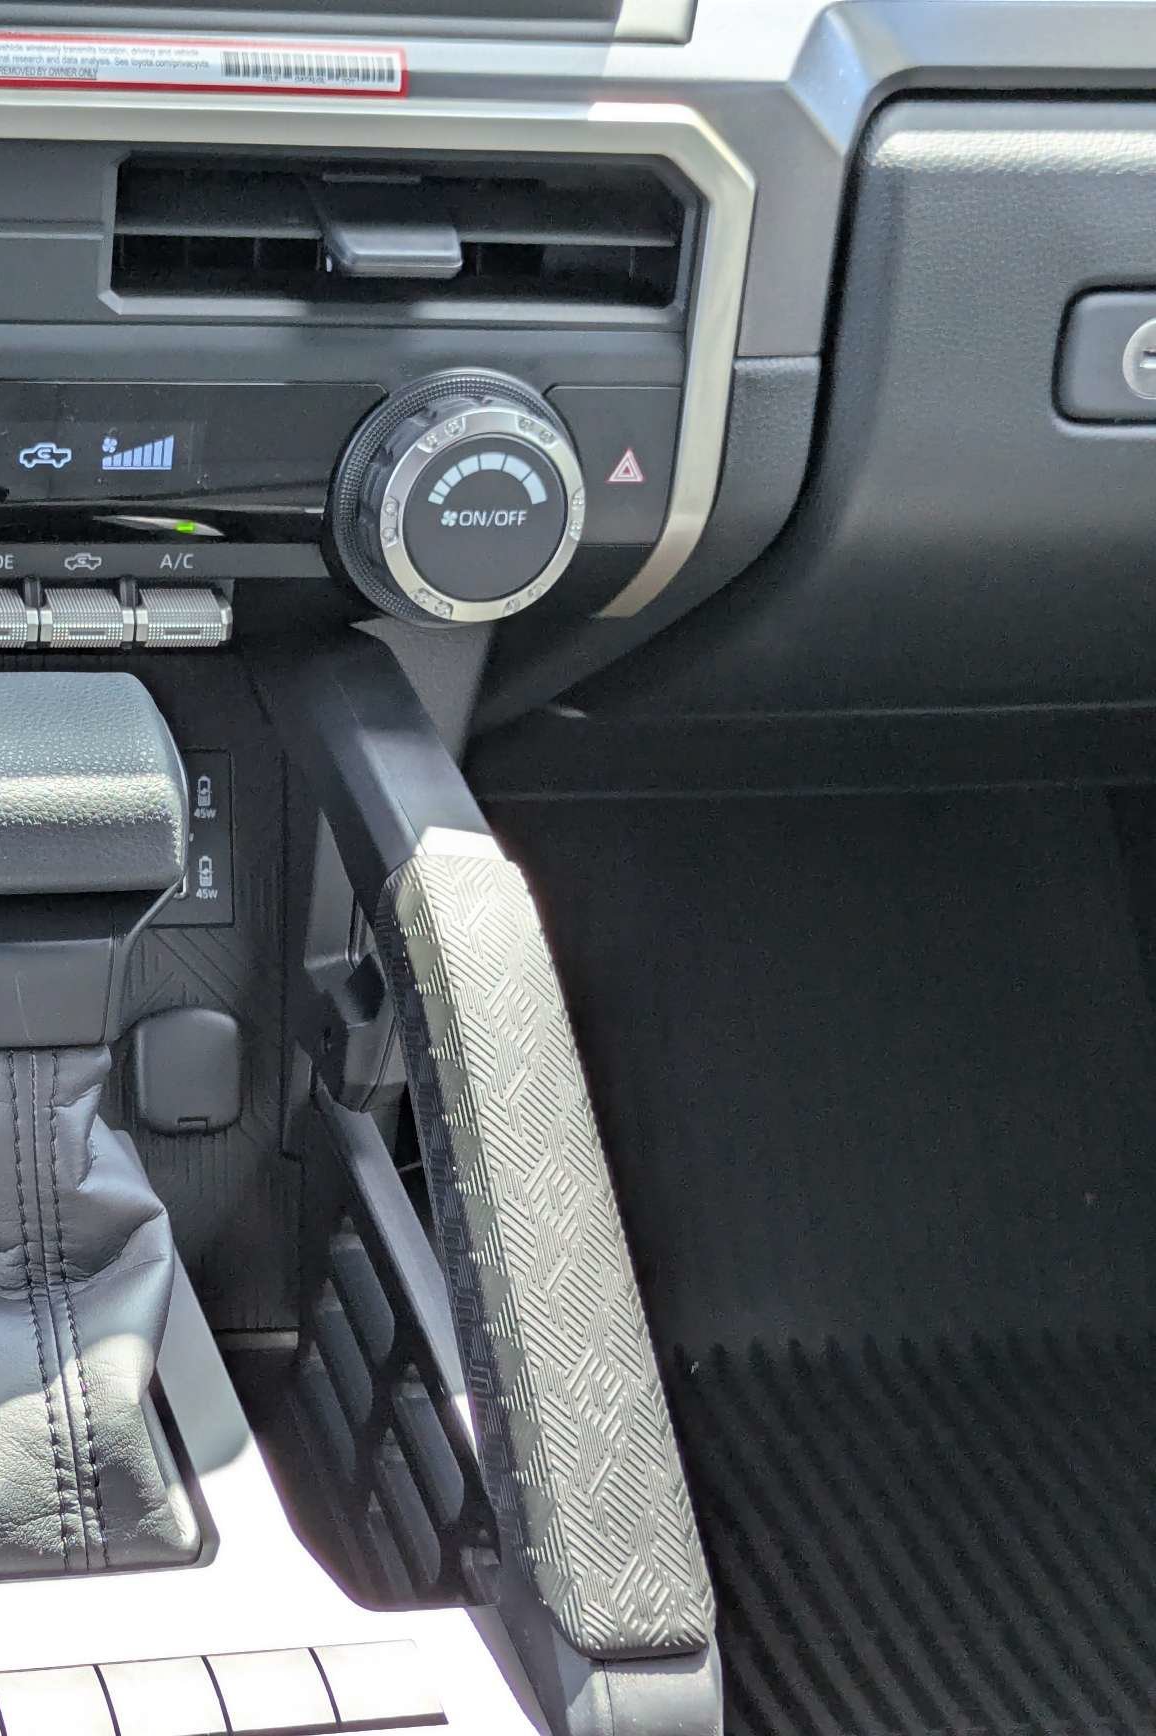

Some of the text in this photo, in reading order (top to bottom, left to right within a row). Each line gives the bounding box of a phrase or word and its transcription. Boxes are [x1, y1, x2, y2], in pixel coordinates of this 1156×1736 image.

[12, 55, 44, 63] research
[47, 55, 61, 64] and
[62, 56, 78, 64] data
[115, 57, 130, 66] See
[37, 66, 47, 76] BY
[48, 66, 77, 77] OWNER
[79, 67, 98, 78] ONLY
[459, 510, 527, 527] ON/OFF
[159, 552, 194, 570] A/C
[193, 808, 217, 819] 45W
[195, 887, 219, 899] 45W
